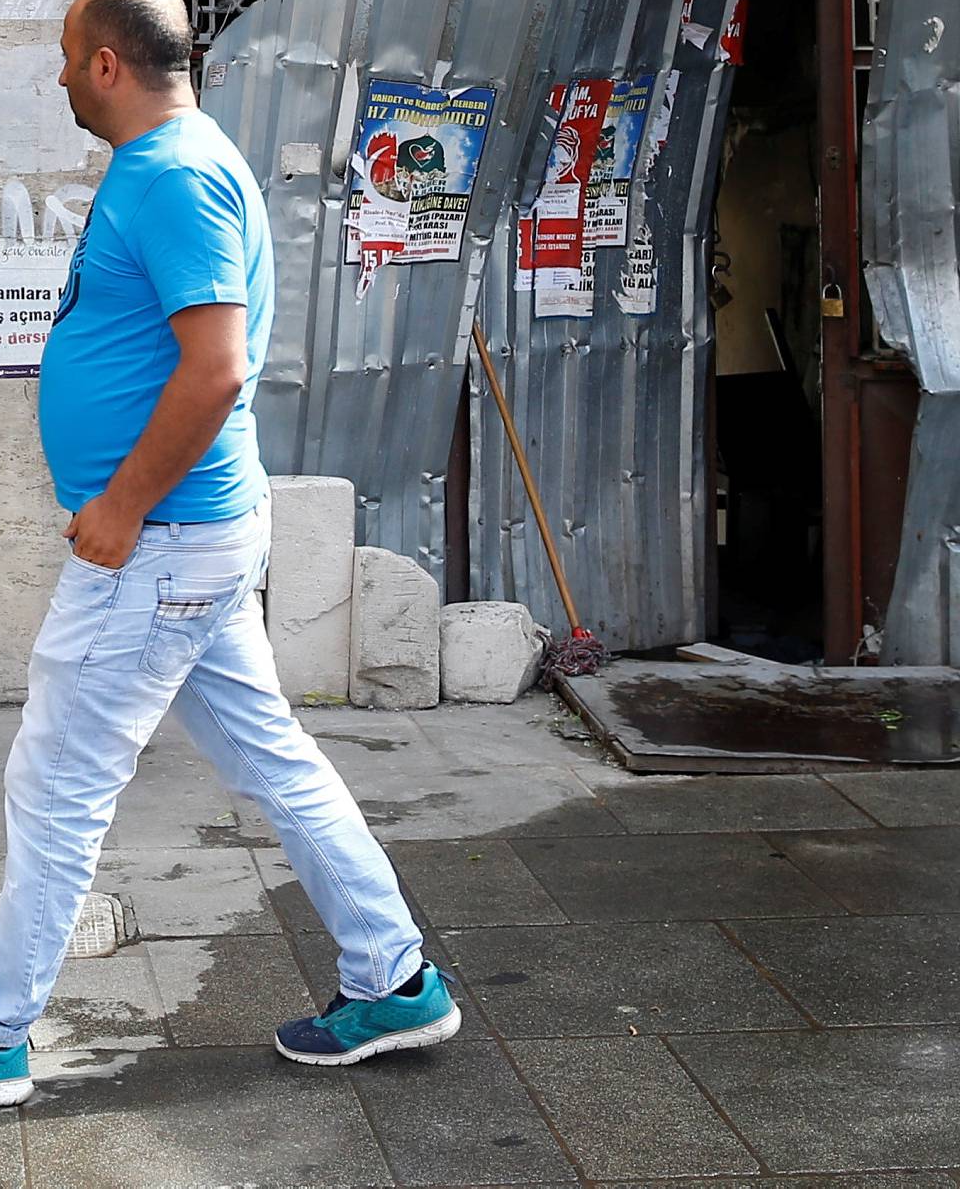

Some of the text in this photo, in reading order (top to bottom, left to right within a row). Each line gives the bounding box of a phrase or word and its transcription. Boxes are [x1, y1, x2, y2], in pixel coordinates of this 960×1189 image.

[371, 93, 404, 104] VAHDET
[443, 196, 468, 211] DAVET
[431, 213, 465, 222] (PAZAR)
[423, 221, 449, 230] ARASI
[432, 232, 457, 240] ALANI
[8, 332, 51, 345] dersi
